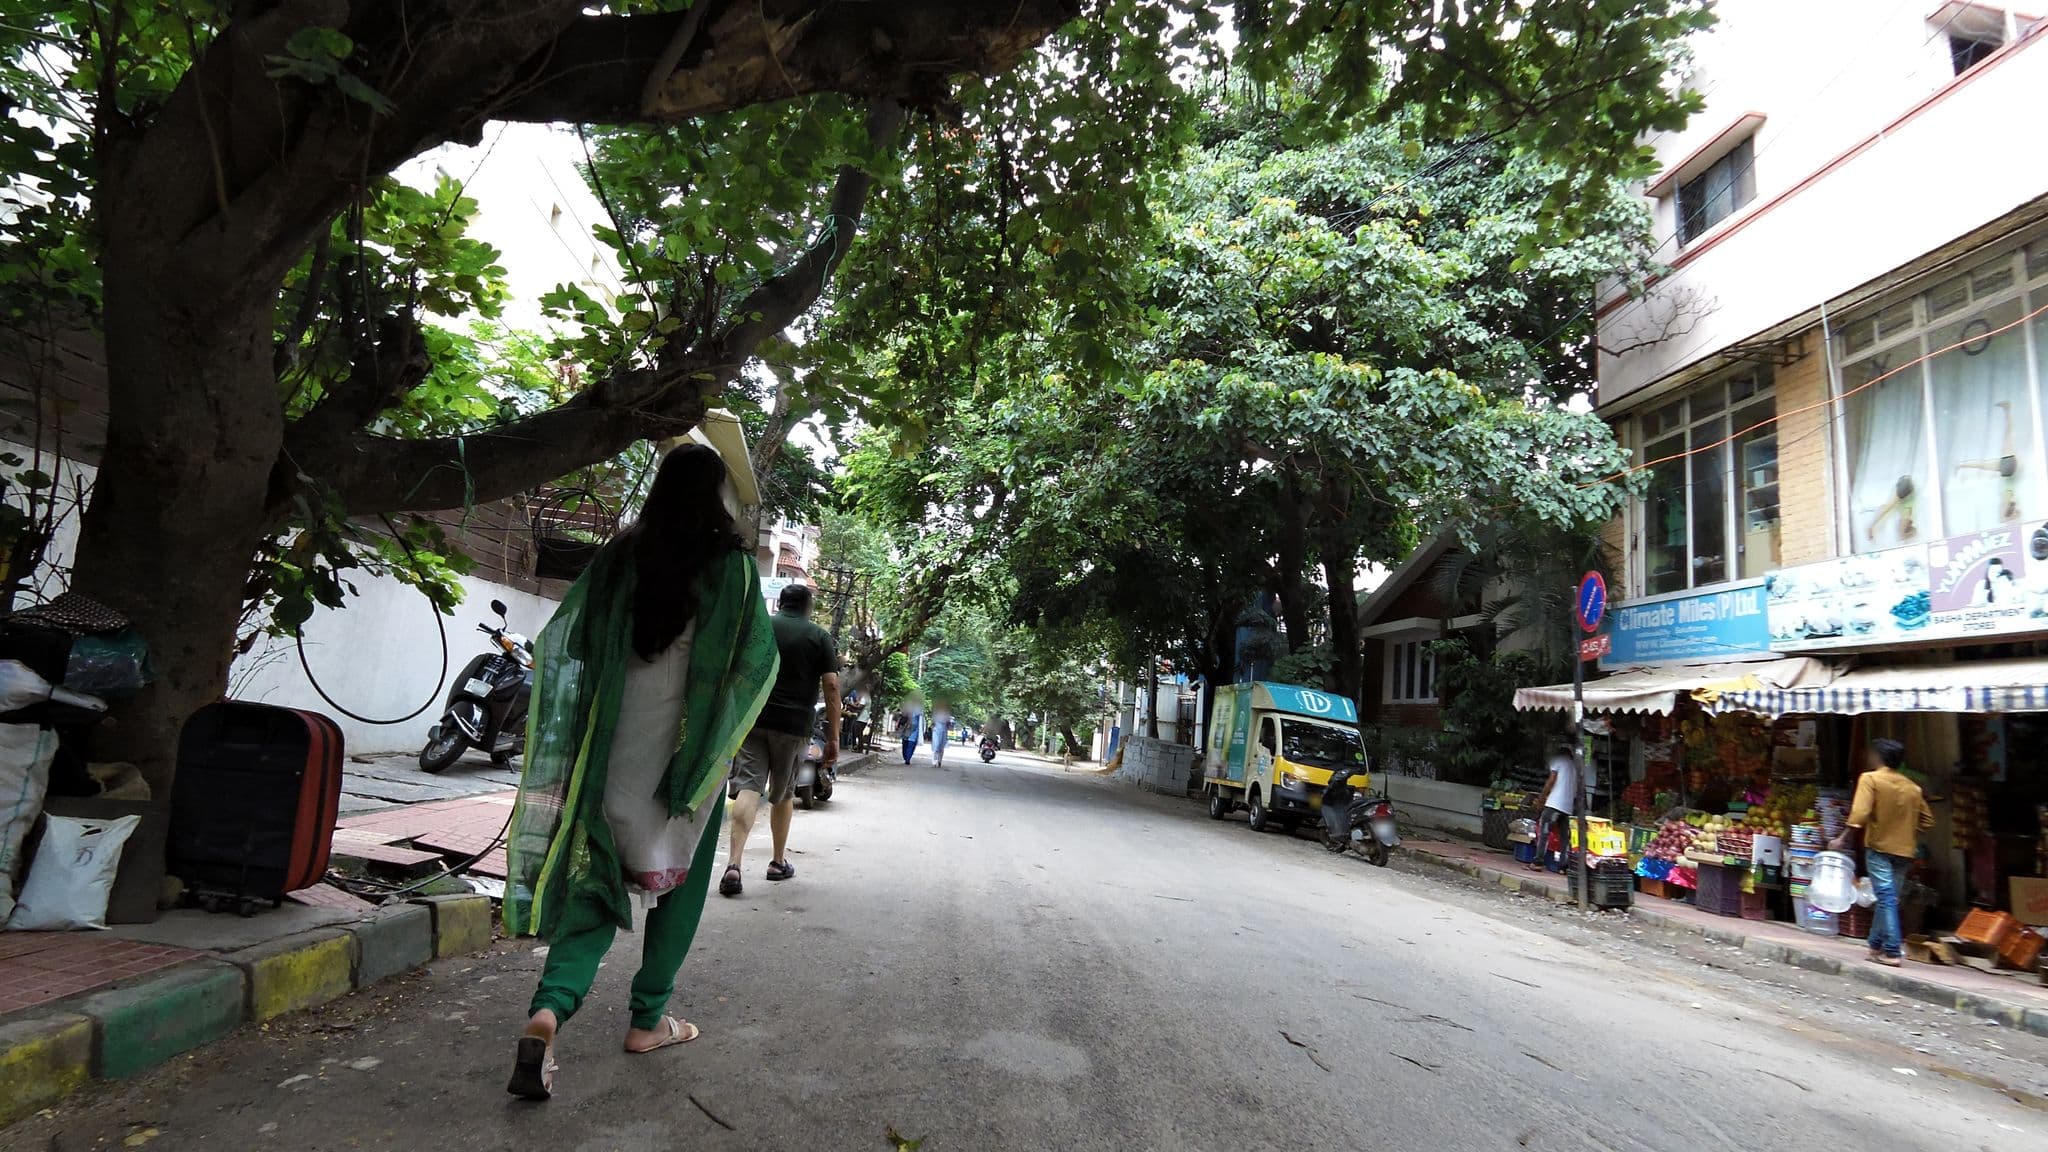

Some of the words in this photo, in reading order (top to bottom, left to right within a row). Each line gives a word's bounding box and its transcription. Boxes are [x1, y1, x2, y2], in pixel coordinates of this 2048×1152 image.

[1619, 604, 1674, 631] Climate
[1965, 607, 2025, 621] DEPARTMENT
[1962, 621, 1995, 631] STORES
